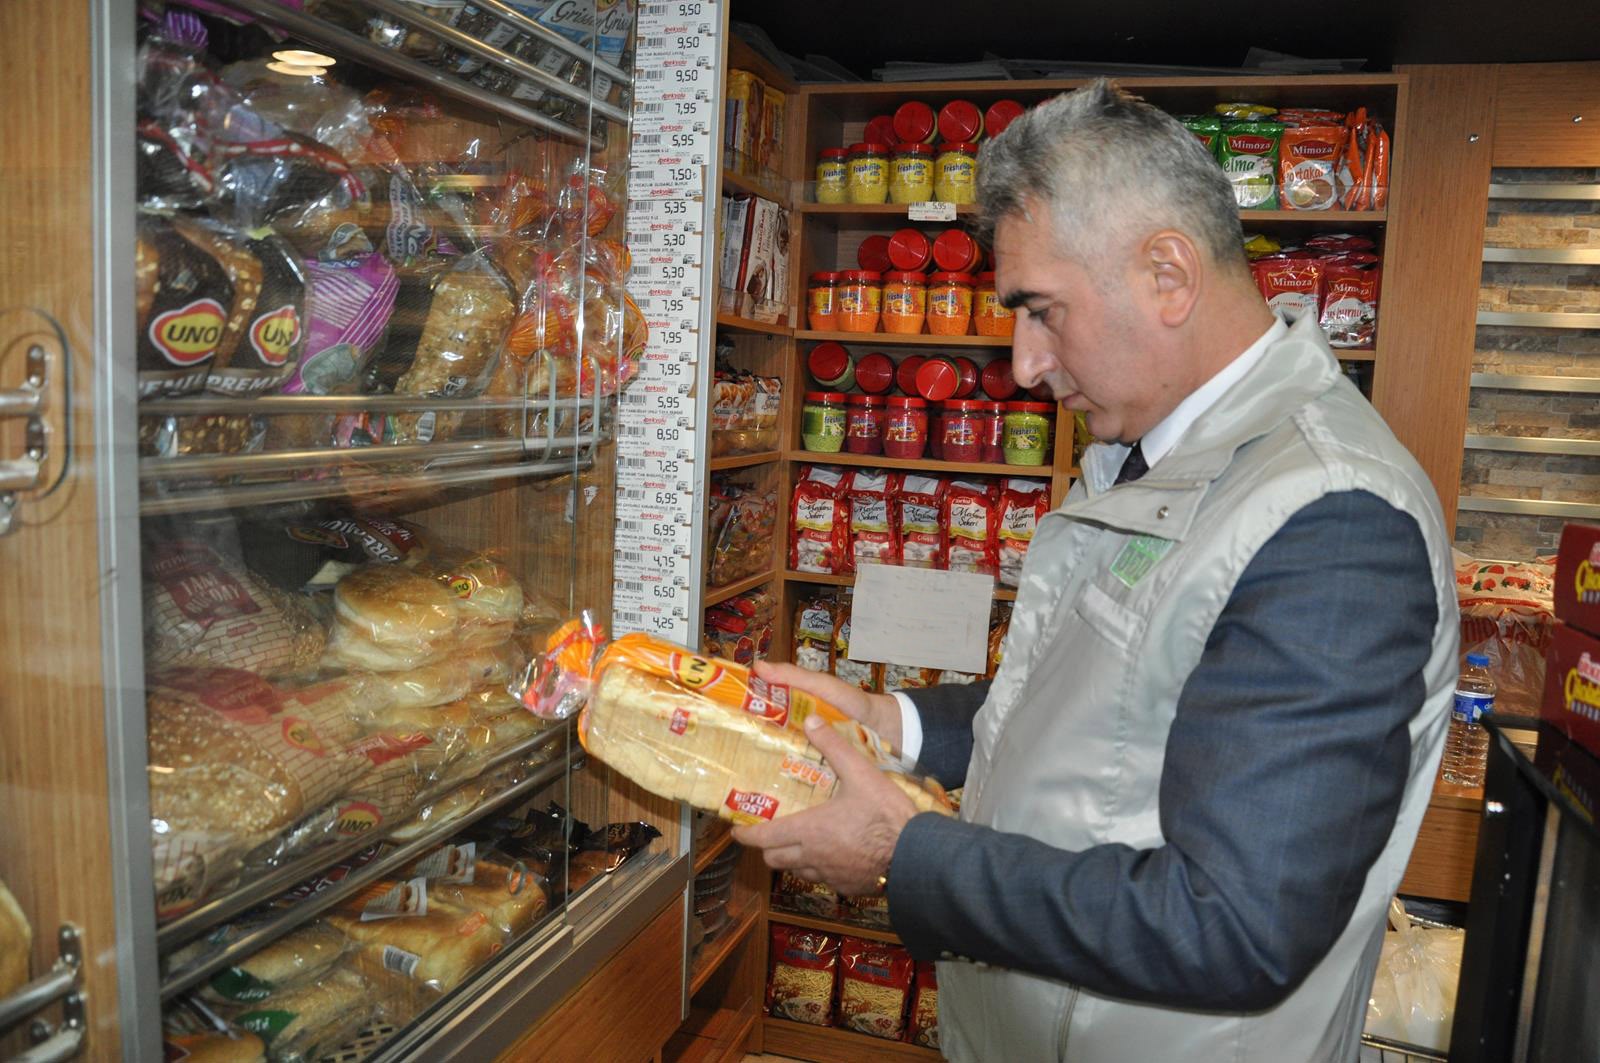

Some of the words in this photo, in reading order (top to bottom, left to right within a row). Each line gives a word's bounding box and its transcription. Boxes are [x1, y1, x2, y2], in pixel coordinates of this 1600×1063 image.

[679, 4, 701, 16] 9,50
[677, 36, 700, 49] 9,50
[676, 70, 698, 82] 9,50
[675, 102, 697, 115] 7,95
[672, 134, 694, 147] 5,95
[1231, 140, 1271, 150] Mimoza
[1293, 146, 1333, 156] Mimoza
[1223, 158, 1256, 172] elma
[664, 202, 687, 214] 5,35
[664, 234, 686, 246] 5,30
[662, 266, 685, 279] 5,30
[1273, 277, 1312, 286] Mimoza
[1334, 284, 1369, 296] Mimoza
[662, 300, 684, 312] 7,95
[167, 324, 218, 344] UNO
[262, 324, 294, 346] UN
[660, 332, 682, 344] 7,95
[659, 364, 681, 376] 7,95
[207, 375, 287, 391] PREMI
[658, 396, 680, 408] 5,95
[656, 428, 679, 440] 8,50
[657, 460, 679, 472] 7,25
[656, 492, 678, 504] 6,95
[654, 524, 676, 536] 6,95
[654, 585, 675, 598] 6,50
